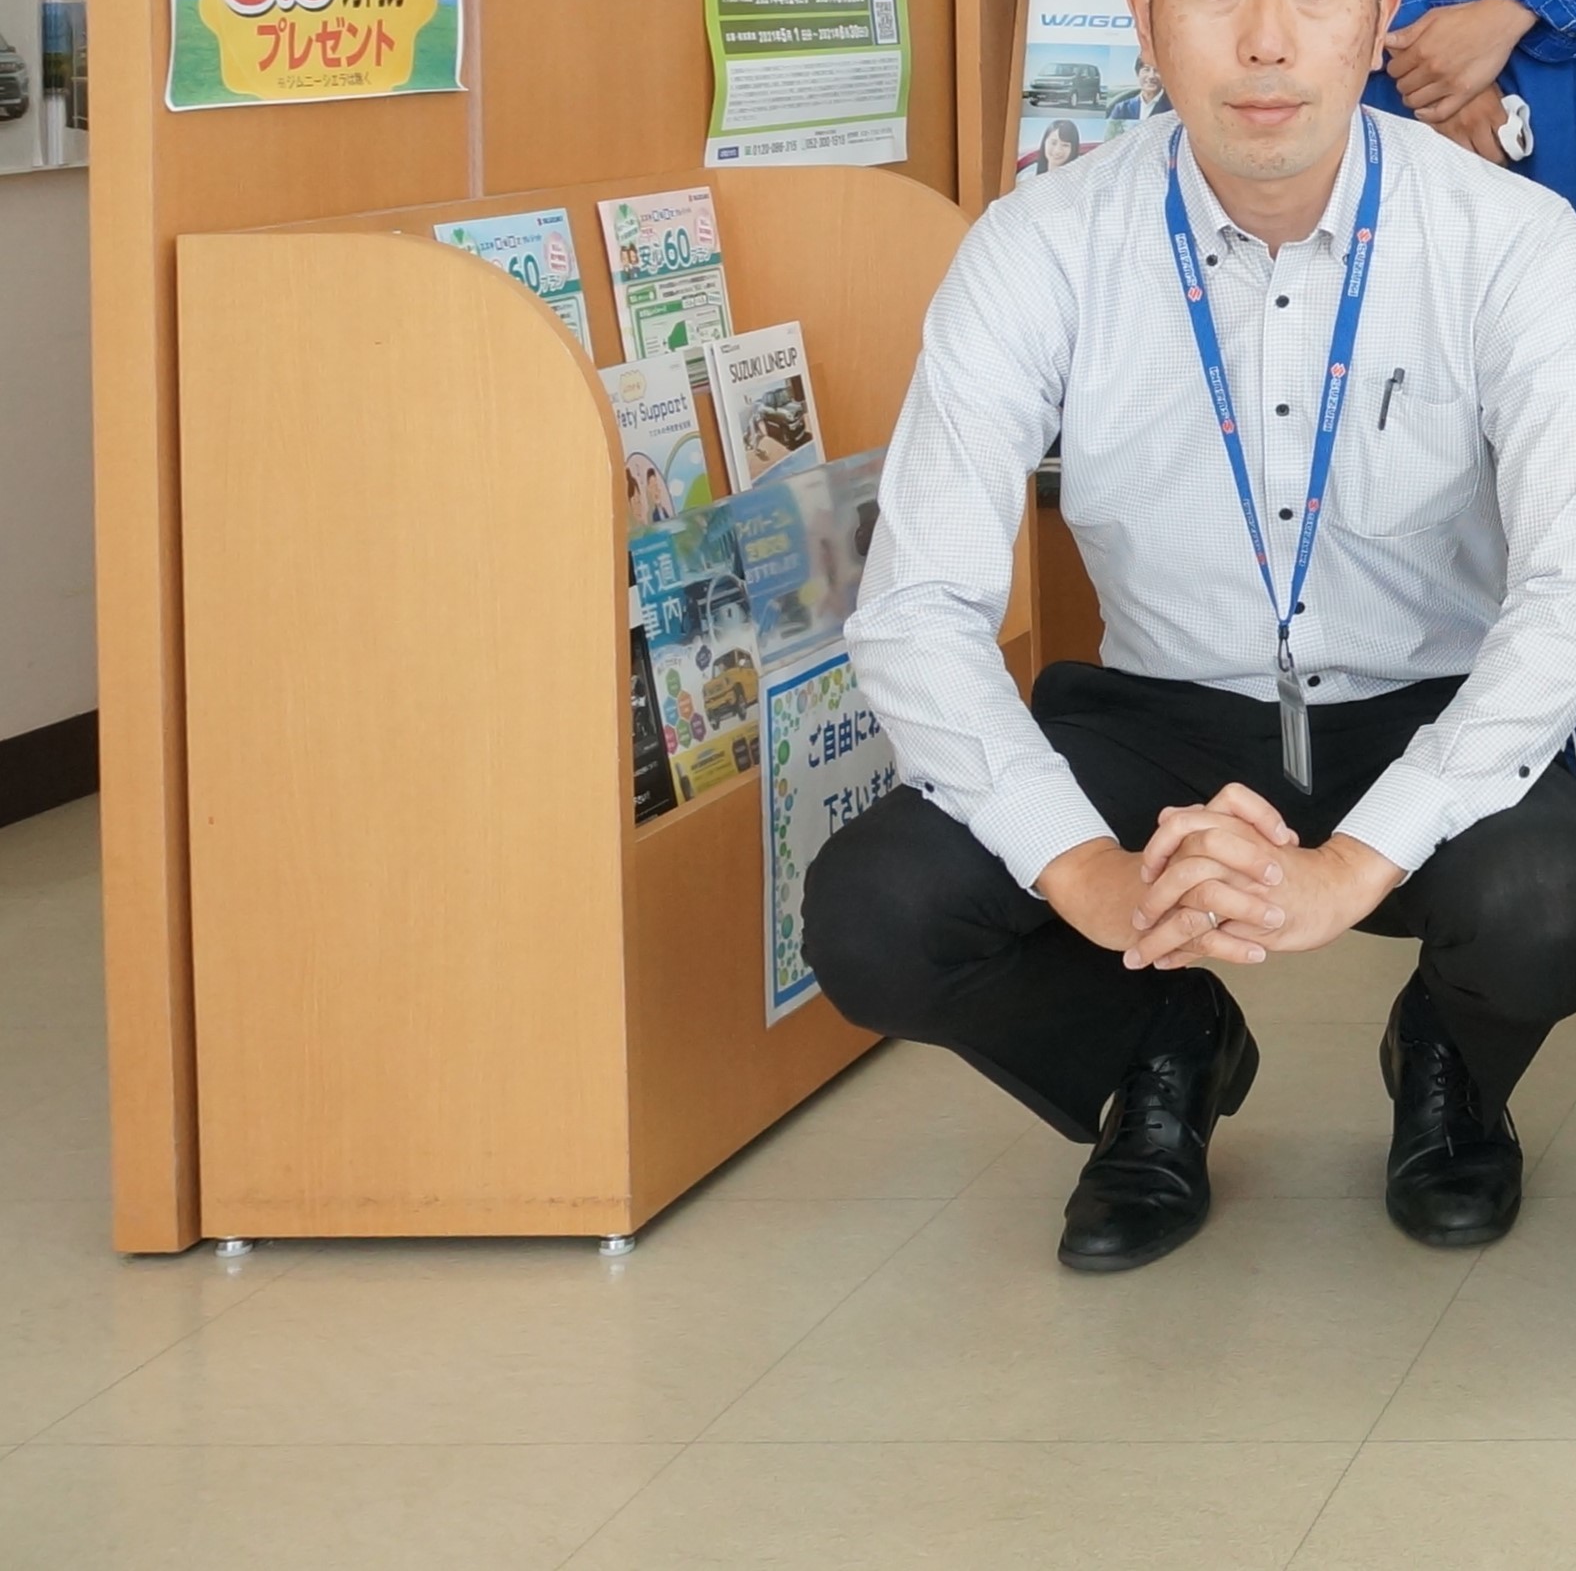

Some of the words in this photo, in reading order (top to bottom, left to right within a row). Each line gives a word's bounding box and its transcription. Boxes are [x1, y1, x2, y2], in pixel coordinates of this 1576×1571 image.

[256, 16, 396, 72] プレゼント
[729, 358, 762, 384] SUZUKI
[763, 346, 798, 374] LINEUP
[639, 393, 689, 423] Support
